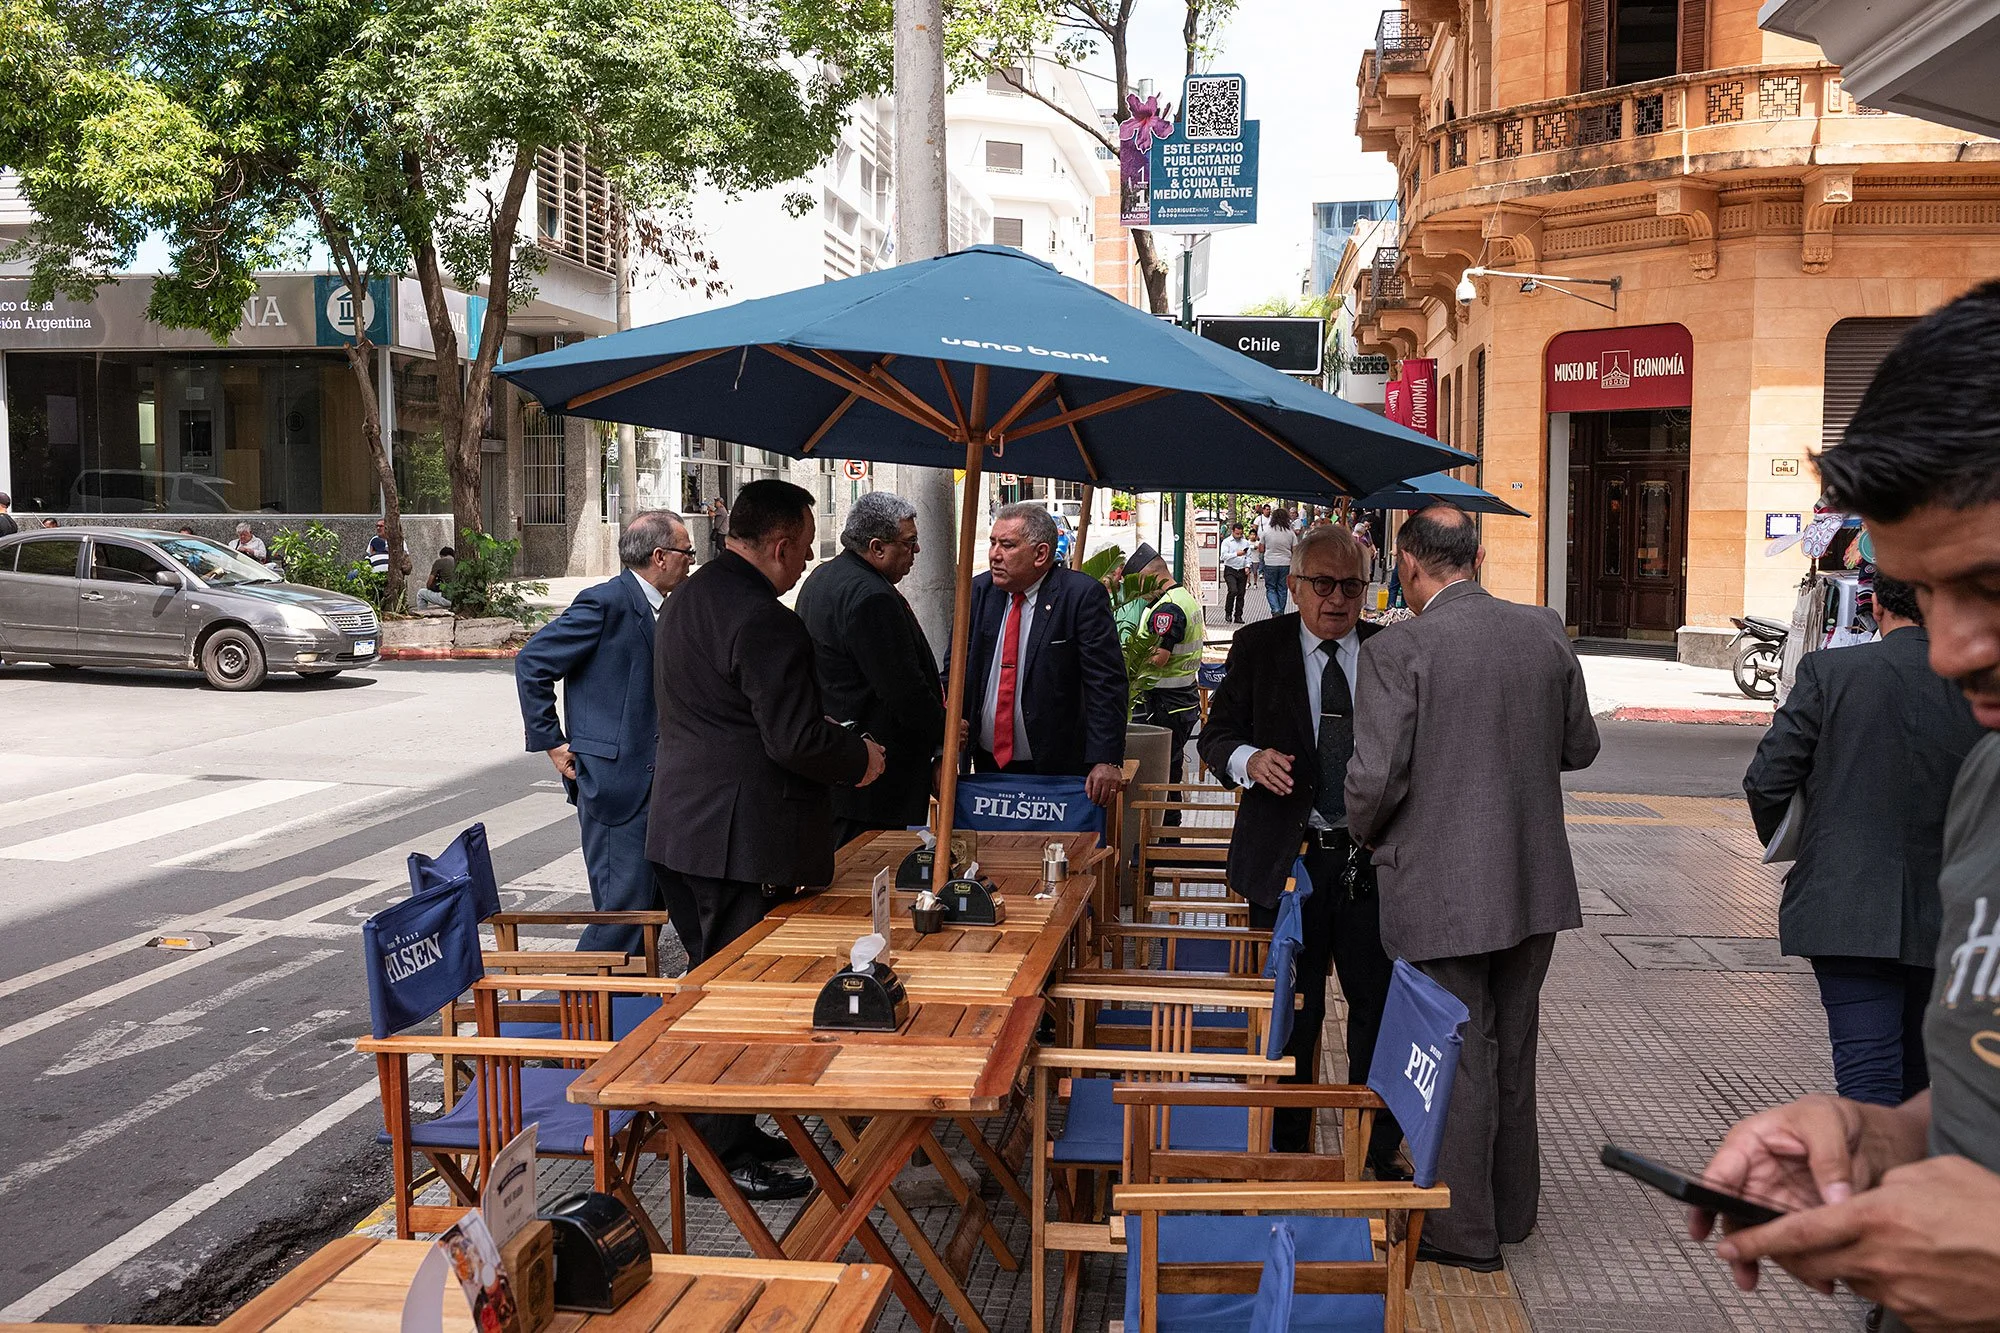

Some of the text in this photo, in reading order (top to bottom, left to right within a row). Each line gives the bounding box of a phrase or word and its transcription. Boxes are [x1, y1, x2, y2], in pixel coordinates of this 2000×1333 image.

[1163, 142, 1243, 154] ESTE ESPACIO
[1163, 154, 1243, 166] PUBLICITARIO
[1166, 165, 1240, 177] TE CONVIENE
[1170, 177, 1235, 188] & CUIDA EL
[1153, 187, 1253, 200] MEDIO AMBIENTE
[0, 301, 17, 311] co
[240, 296, 287, 326] NA
[25, 316, 91, 332] Argentina
[941, 337, 1110, 364] ueno bank
[1238, 337, 1280, 351] Chile
[1554, 352, 1685, 382] MUSEO DE ECONOMÍA
[1411, 378, 1428, 429] ECONOMÍA
[973, 796, 1067, 821] PILSEN
[384, 932, 443, 984] PILSEN
